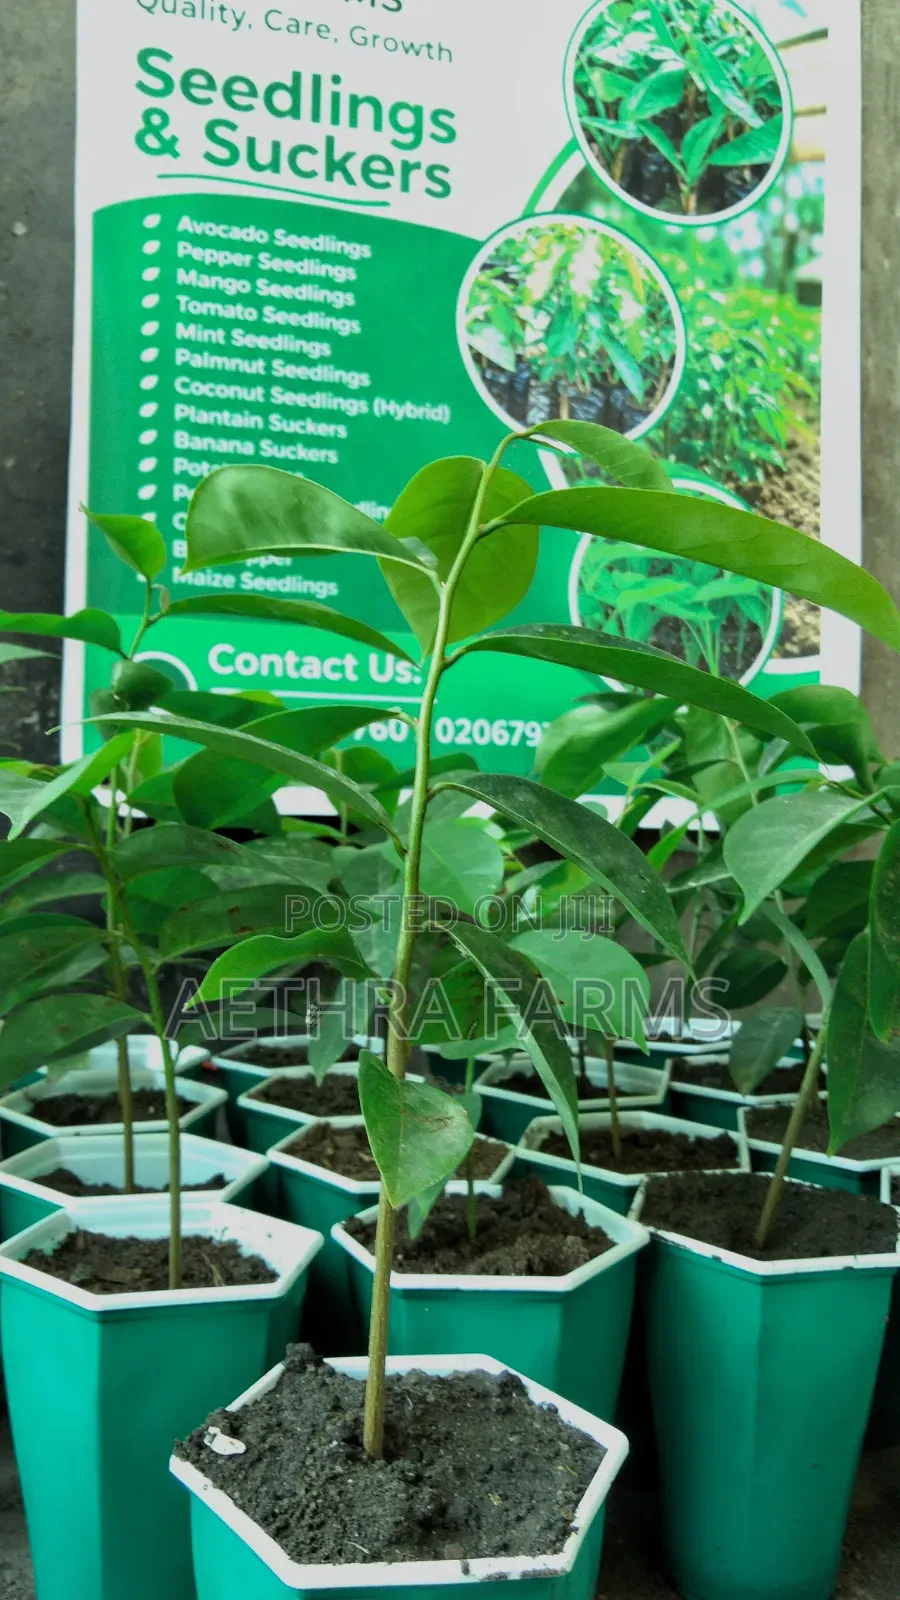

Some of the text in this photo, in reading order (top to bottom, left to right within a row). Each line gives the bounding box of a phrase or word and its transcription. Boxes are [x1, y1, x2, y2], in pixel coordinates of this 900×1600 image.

[349, 25, 453, 63] Growth
[135, 47, 457, 151] Seedlings
[134, 107, 452, 199] & Suckers
[177, 215, 372, 260] Avocado Seedlings
[177, 241, 357, 282] Pepper Seedlings
[176, 268, 355, 308] Mango Seedlings
[175, 294, 361, 336] Tomato Seedlings
[175, 322, 331, 359] Mint Seedlings
[175, 348, 371, 389] Palmnut Seedlings
[174, 376, 450, 424] Coconut Seedlings (Hybrid)
[174, 403, 348, 439] Plantain Suckers
[173, 430, 338, 464] Banana Suckers
[172, 566, 338, 599] Maize Seedlings
[207, 643, 358, 683] Contact
[434, 716, 552, 748] 020679
